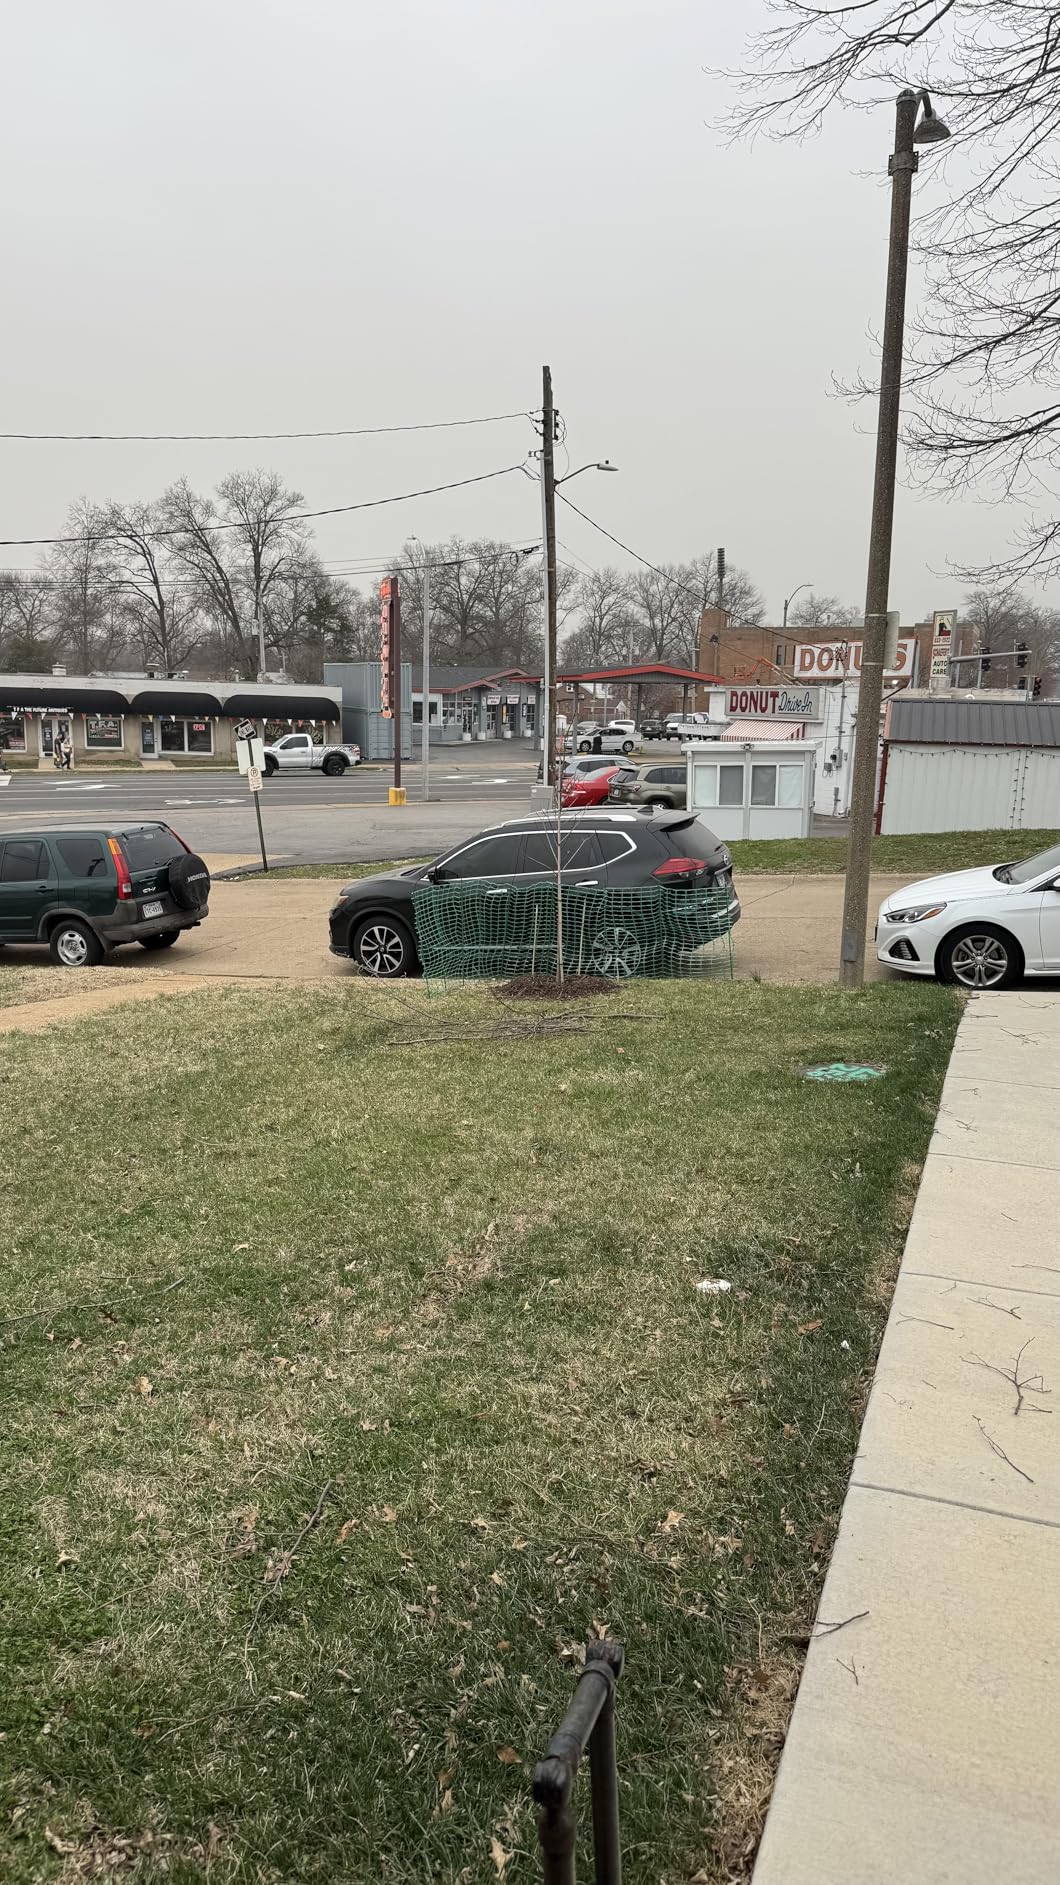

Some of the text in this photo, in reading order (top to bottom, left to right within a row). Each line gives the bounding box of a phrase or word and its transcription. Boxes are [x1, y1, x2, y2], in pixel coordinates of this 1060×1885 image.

[800, 643, 907, 672] DONUS
[729, 690, 779, 714] DONUT
[778, 691, 802, 712] Drive
[187, 872, 208, 882] HONDA
